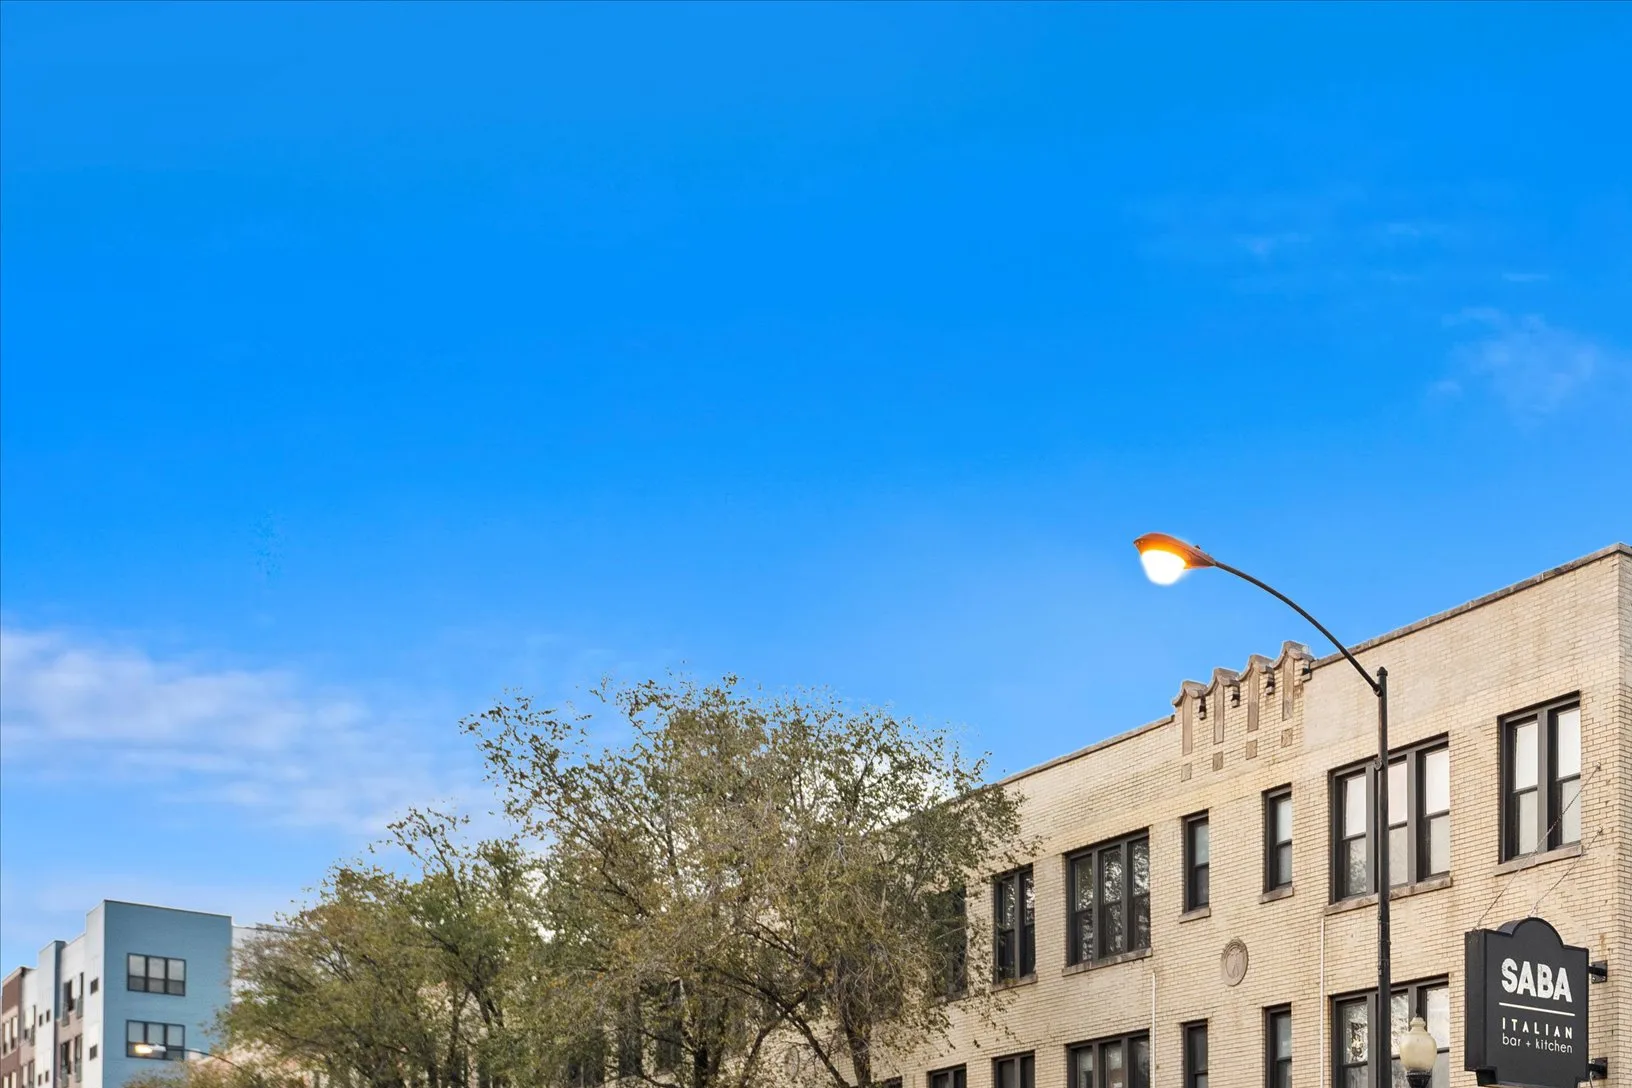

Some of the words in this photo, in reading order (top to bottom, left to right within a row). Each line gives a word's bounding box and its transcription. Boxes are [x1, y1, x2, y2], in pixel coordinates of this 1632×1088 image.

[1501, 958, 1573, 1003] SABA
[1502, 1017, 1573, 1039] ITALIAN
[1502, 1033, 1521, 1046] bar
[1535, 1038, 1573, 1054] kitchen
